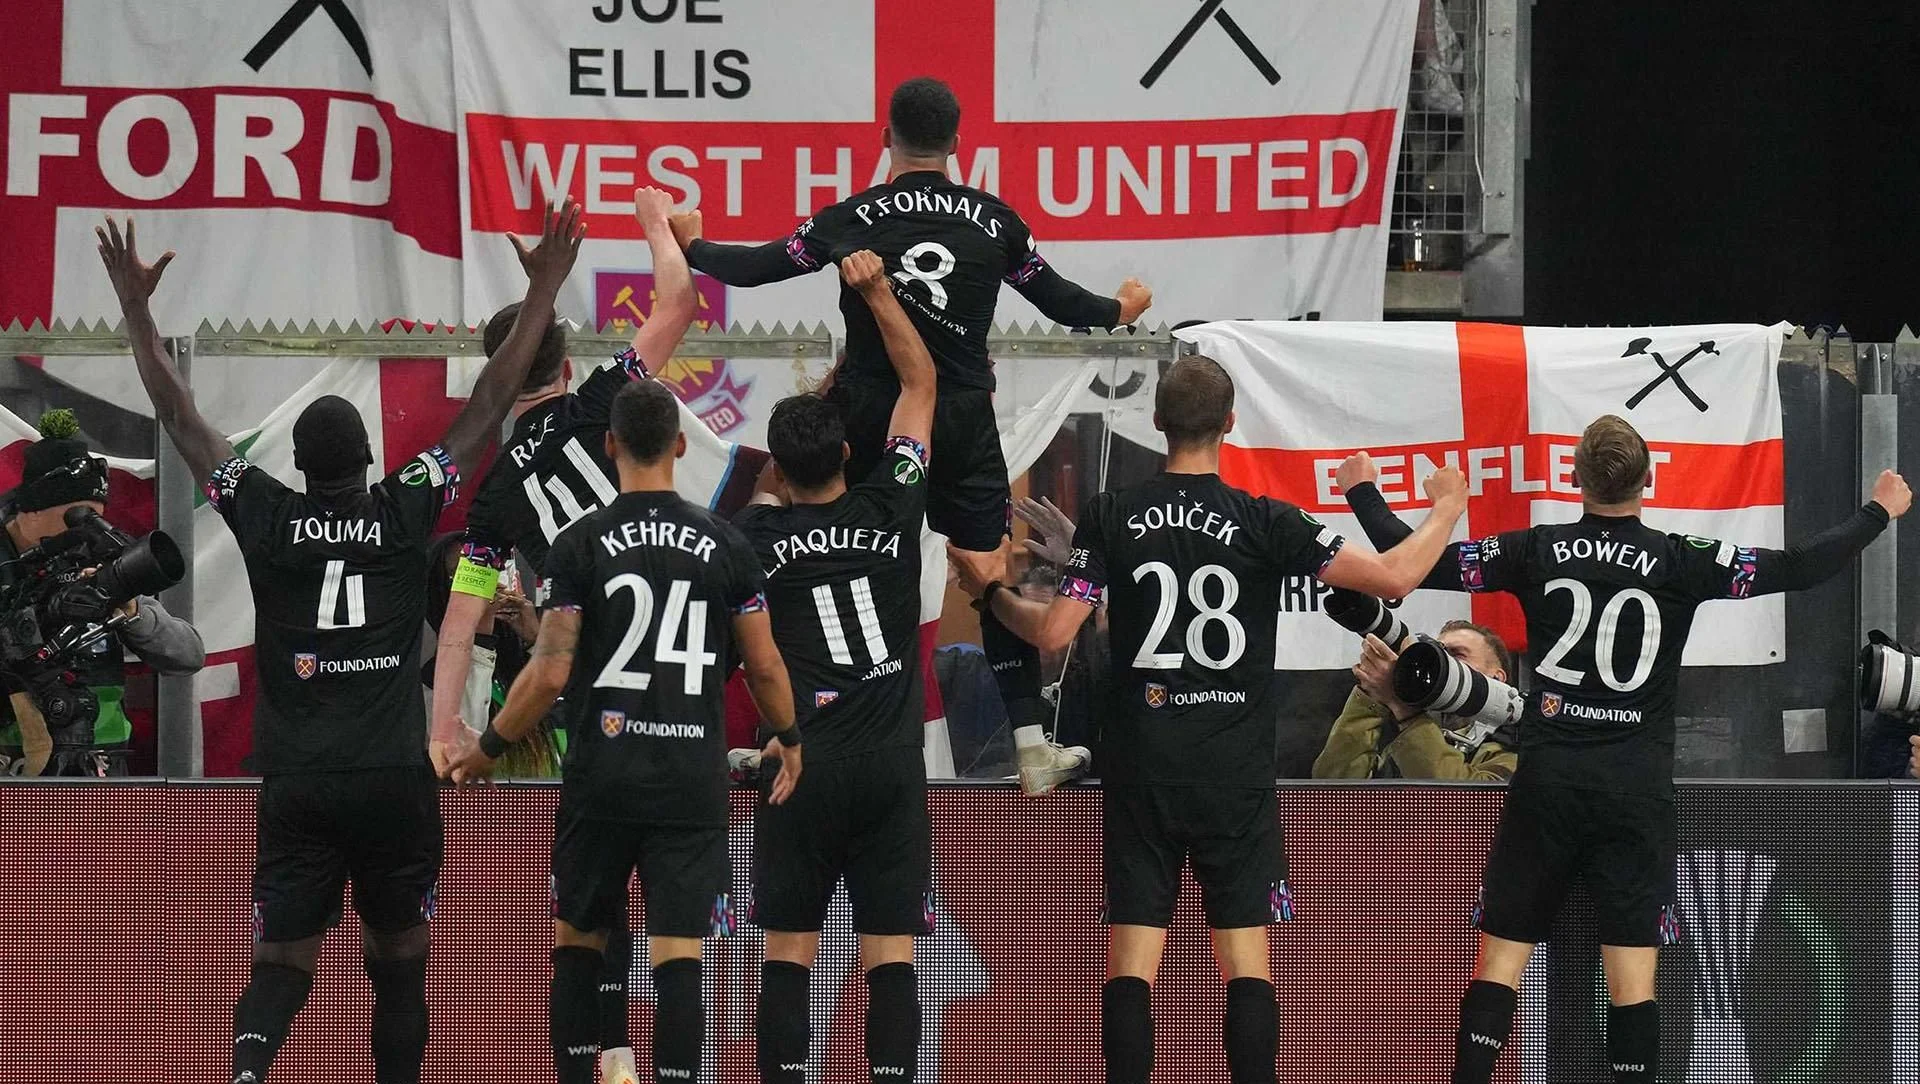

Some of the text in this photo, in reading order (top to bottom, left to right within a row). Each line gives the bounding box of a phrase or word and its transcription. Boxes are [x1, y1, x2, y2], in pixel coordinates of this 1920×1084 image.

[569, 48, 752, 99] ELLIS
[6, 92, 392, 206] FORD
[501, 140, 762, 217] WEST
[1038, 137, 1369, 218] UNITED
[855, 190, 1002, 239] P.FORNALS
[892, 241, 956, 310] 8
[522, 436, 619, 547] 41
[1313, 445, 1672, 505] BENFLET
[290, 517, 382, 547] ZOUMA
[600, 520, 717, 563] KEHRER
[1127, 501, 1241, 546] SOUČEK
[762, 526, 902, 579] L.PAQUETÁ
[1552, 538, 1658, 577] BOWEN
[316, 559, 366, 630] 4
[1131, 561, 1247, 670] 28
[592, 572, 717, 695] 24
[811, 575, 889, 666] 11
[1535, 577, 1662, 692] 20
[319, 654, 400, 673] FOUNDATION
[1169, 690, 1246, 705] FOUNDATION
[1562, 702, 1642, 724] FOUNDATION
[625, 719, 705, 739] FOUNDATION
[1470, 1032, 1502, 1050] WHU
[658, 1066, 691, 1079] WHU
[872, 1065, 905, 1076] WHU
[1612, 1063, 1645, 1073] WHU
